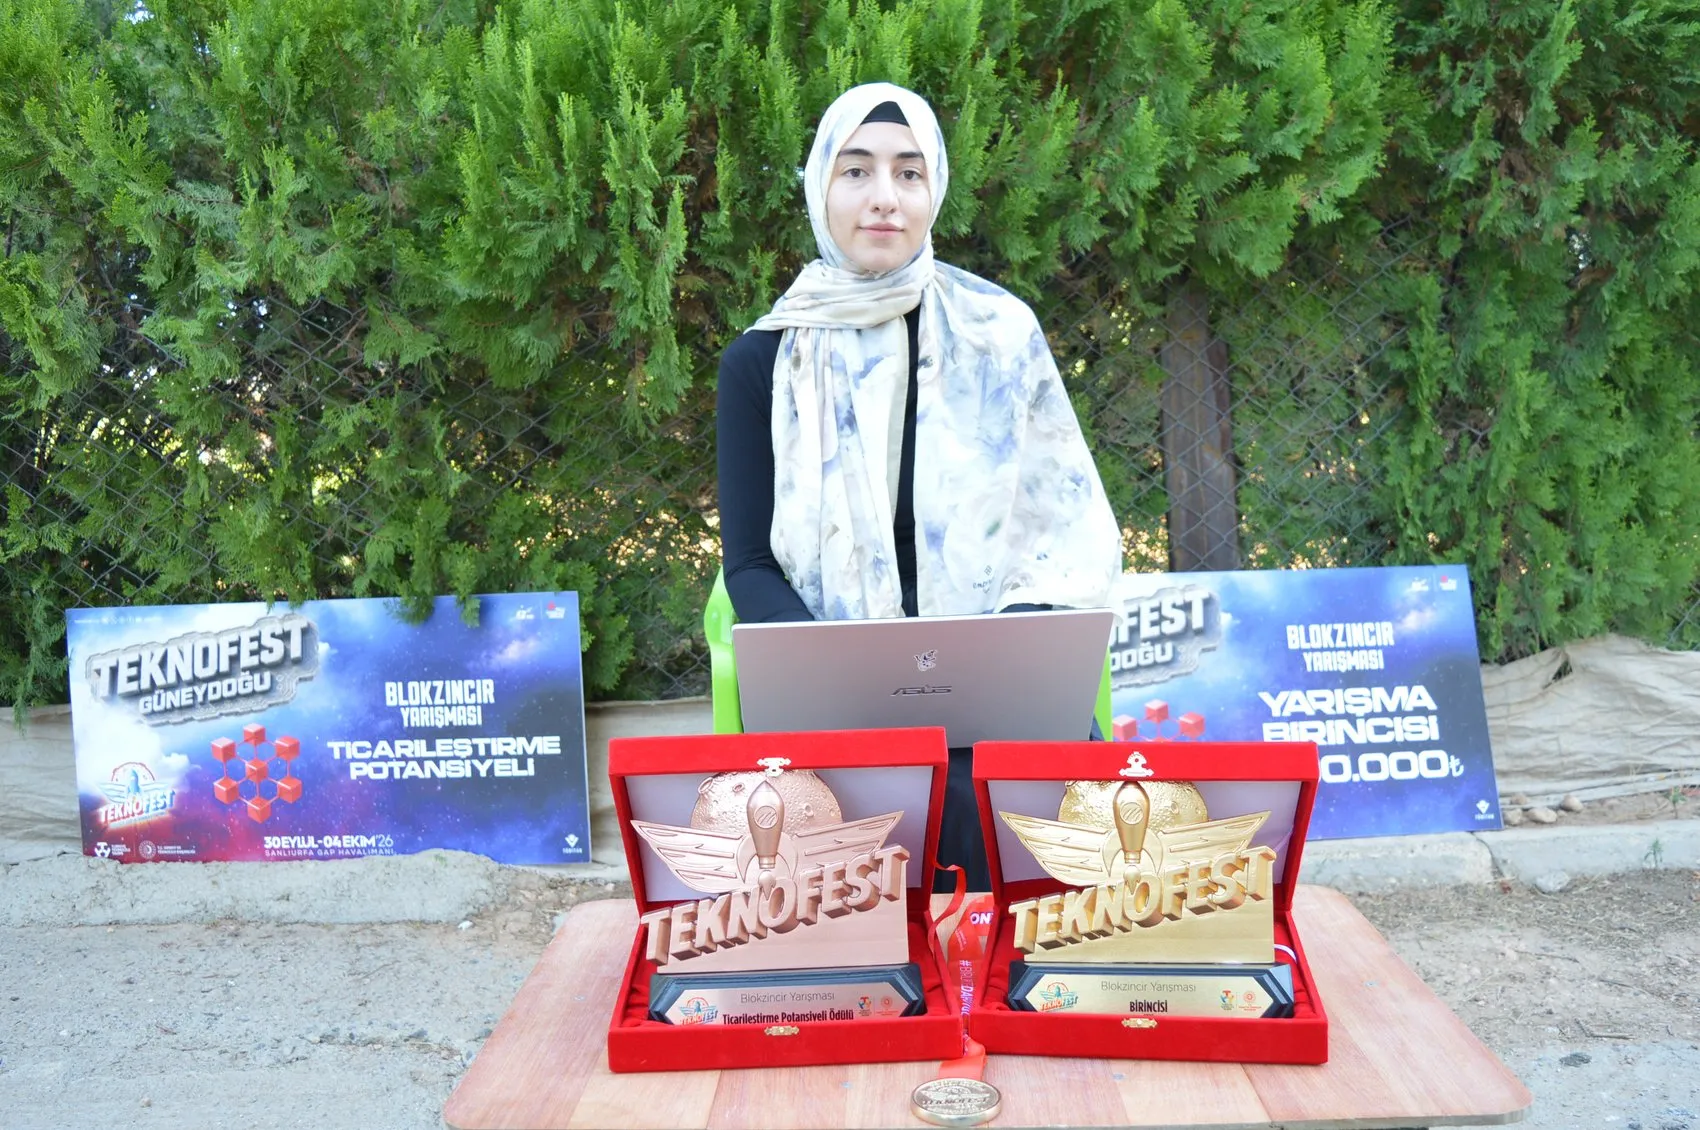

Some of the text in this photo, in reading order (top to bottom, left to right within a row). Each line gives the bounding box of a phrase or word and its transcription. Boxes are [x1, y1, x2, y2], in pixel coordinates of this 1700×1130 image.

[92, 619, 309, 697] TEKNOFEST
[1303, 649, 1384, 672] YARIŞMASI
[139, 671, 271, 713] GÜNEYDOĞU
[890, 684, 952, 696] ASUS
[1258, 685, 1438, 717] YARIŞMA
[400, 705, 483, 728] YARIŞMASI
[97, 789, 175, 824] TEKNOFEST
[641, 844, 910, 964] TEKNOFEST
[1008, 845, 1278, 954] TEKNOFEST
[1101, 980, 1147, 990] Blokzincir
[740, 992, 787, 1003] Blokzincir
[1129, 999, 1168, 1012] BİRİNCİSİ
[829, 1008, 854, 1021] Ödülü
